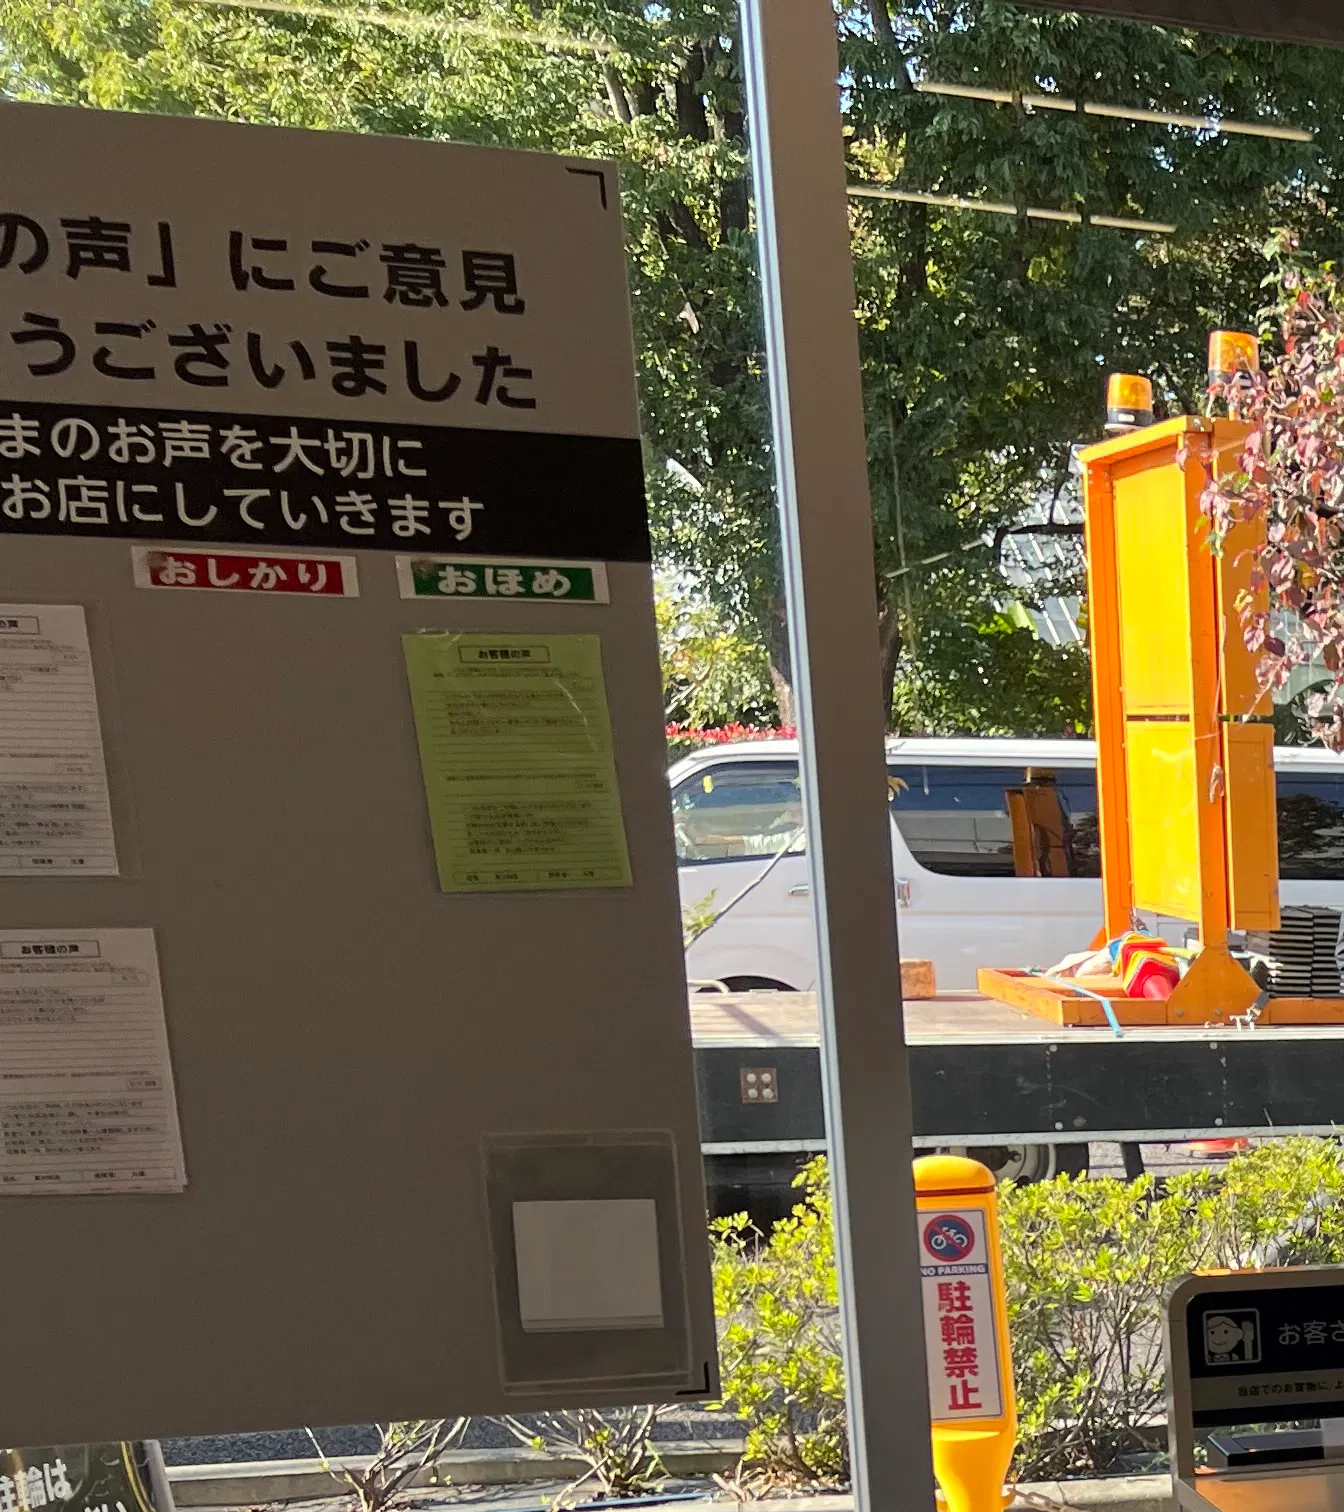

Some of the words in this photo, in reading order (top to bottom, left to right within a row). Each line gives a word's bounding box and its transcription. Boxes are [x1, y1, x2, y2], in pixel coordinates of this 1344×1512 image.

[10, 311, 537, 411] うございました
[0, 412, 428, 480] まのお声を大切に
[2, 473, 485, 542] お店にしていきます
[158, 553, 329, 590] おしかり
[437, 563, 573, 599] おほめ
[937, 1263, 986, 1276] PARKING
[937, 1280, 983, 1411] 駐輪禁止
